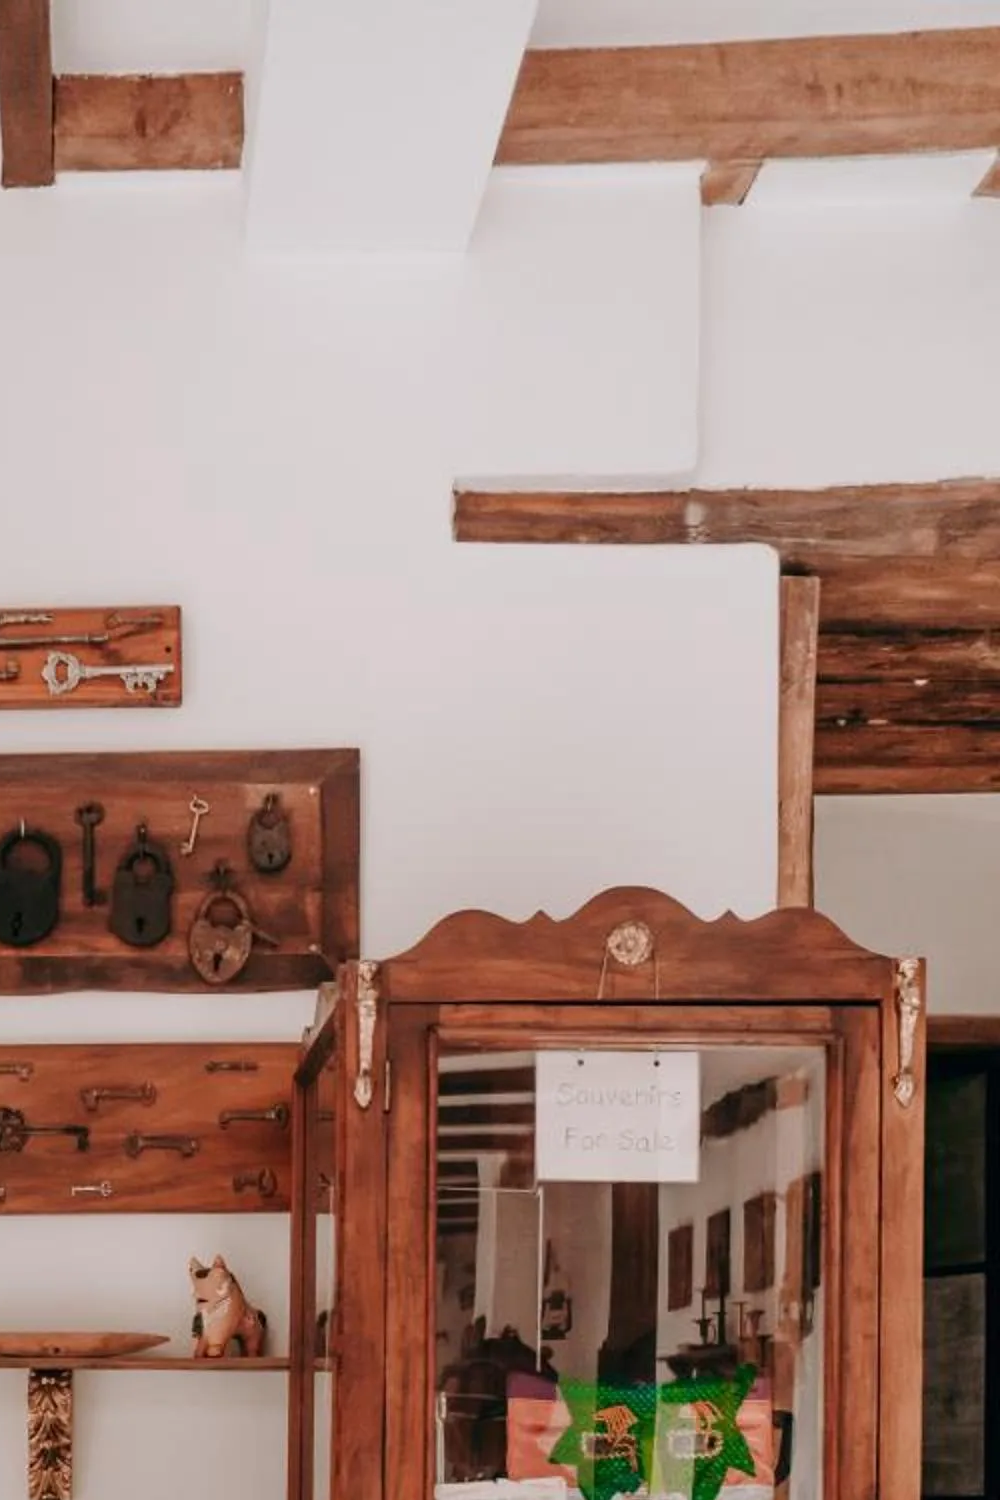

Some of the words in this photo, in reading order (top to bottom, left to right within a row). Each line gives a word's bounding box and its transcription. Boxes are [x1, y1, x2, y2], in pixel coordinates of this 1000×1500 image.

[556, 1081, 682, 1107] Souvenirs
[564, 1126, 606, 1152] For
[618, 1127, 676, 1153] Sale
